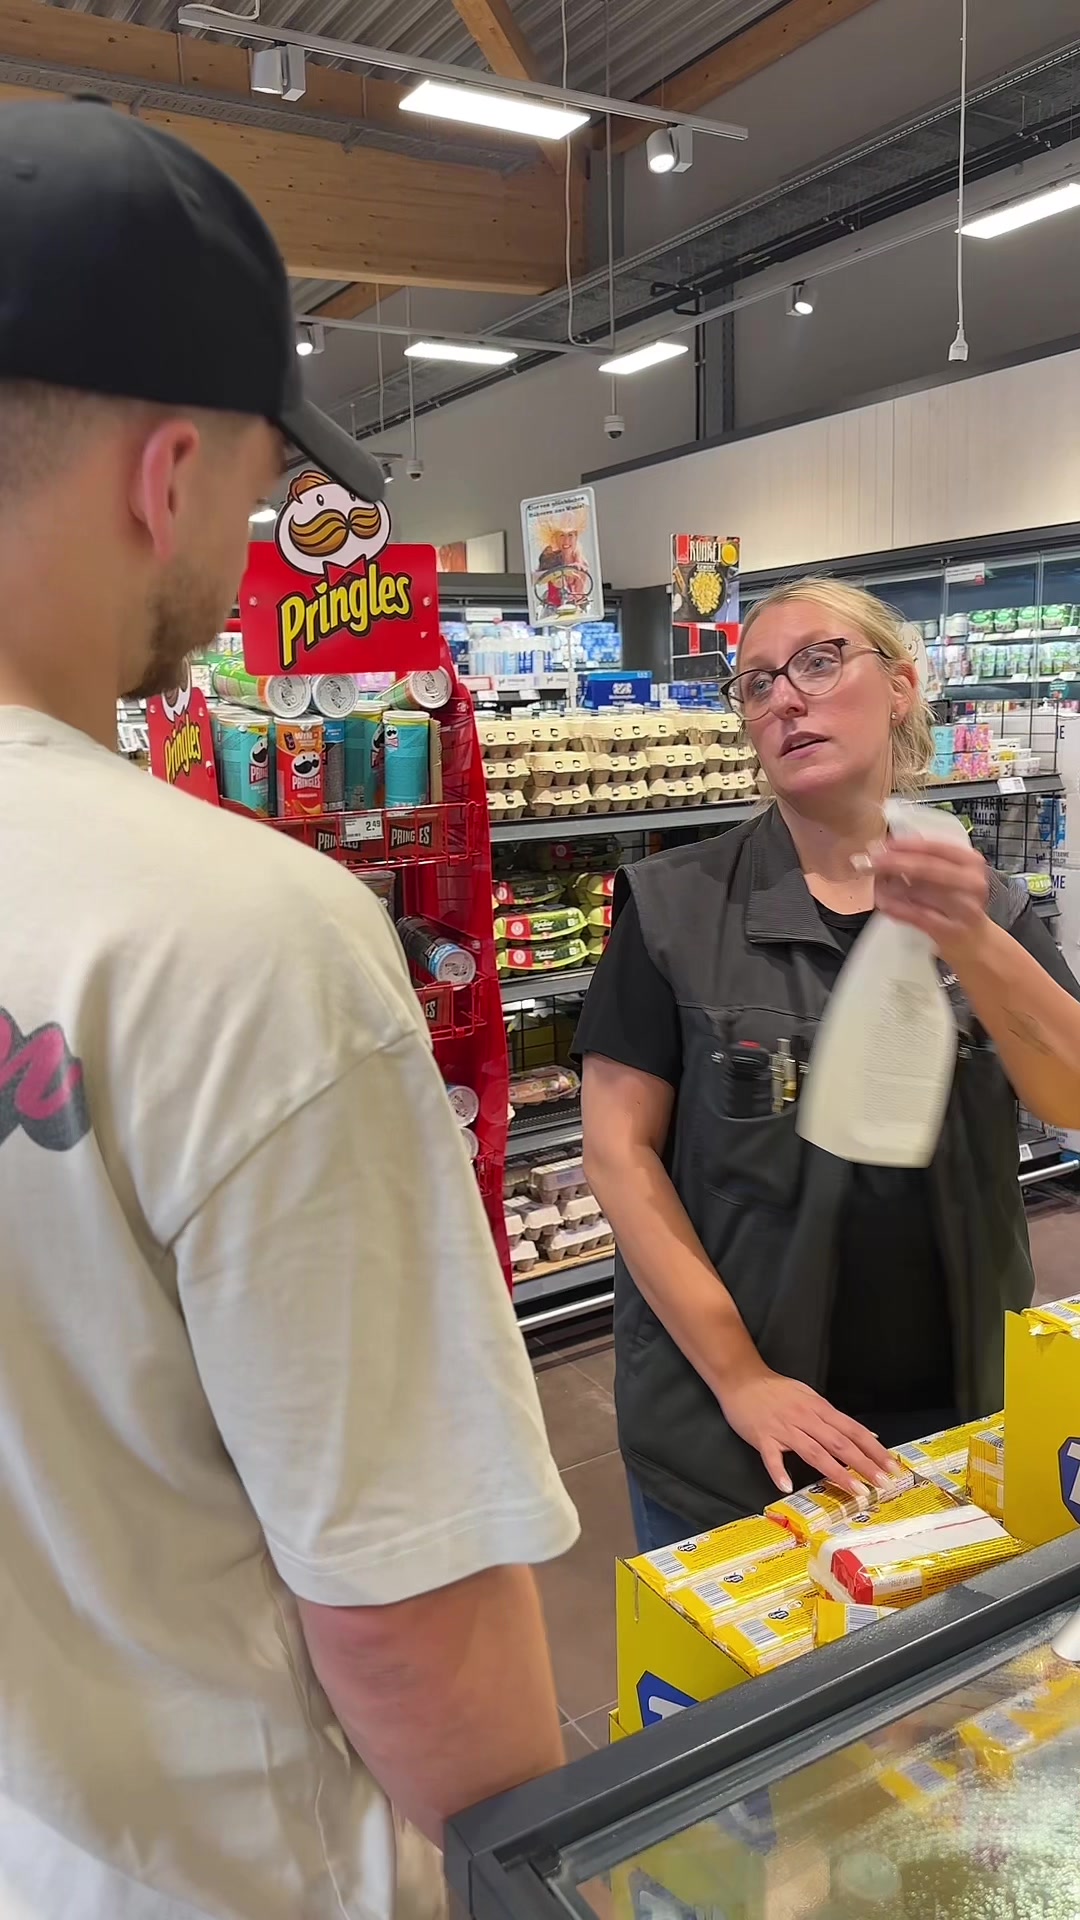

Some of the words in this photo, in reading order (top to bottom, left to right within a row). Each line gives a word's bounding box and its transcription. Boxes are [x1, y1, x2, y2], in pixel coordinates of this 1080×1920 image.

[280, 562, 411, 667] Pringles
[164, 713, 202, 785] Pringles
[291, 774, 321, 791] PRINGLES
[365, 820, 381, 832] 2.49
[391, 825, 431, 847] PRINGES
[425, 1000, 436, 1019] ES
